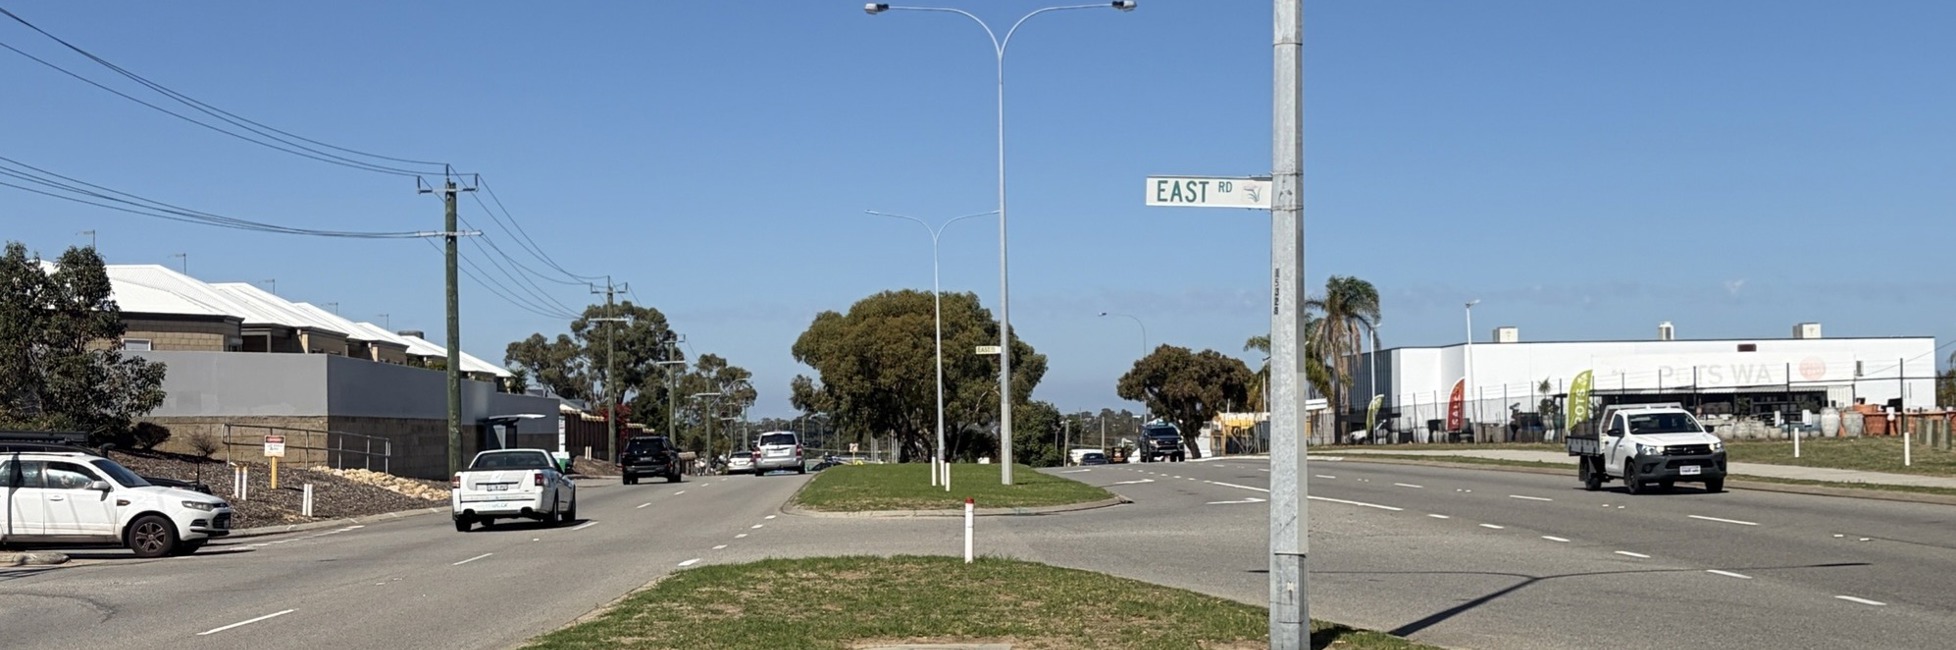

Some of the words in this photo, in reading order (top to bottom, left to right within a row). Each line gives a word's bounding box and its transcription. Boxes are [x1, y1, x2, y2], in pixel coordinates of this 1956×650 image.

[1157, 180, 1210, 203] EAST
[1218, 181, 1233, 193] RD
[1731, 364, 1773, 384] WA
